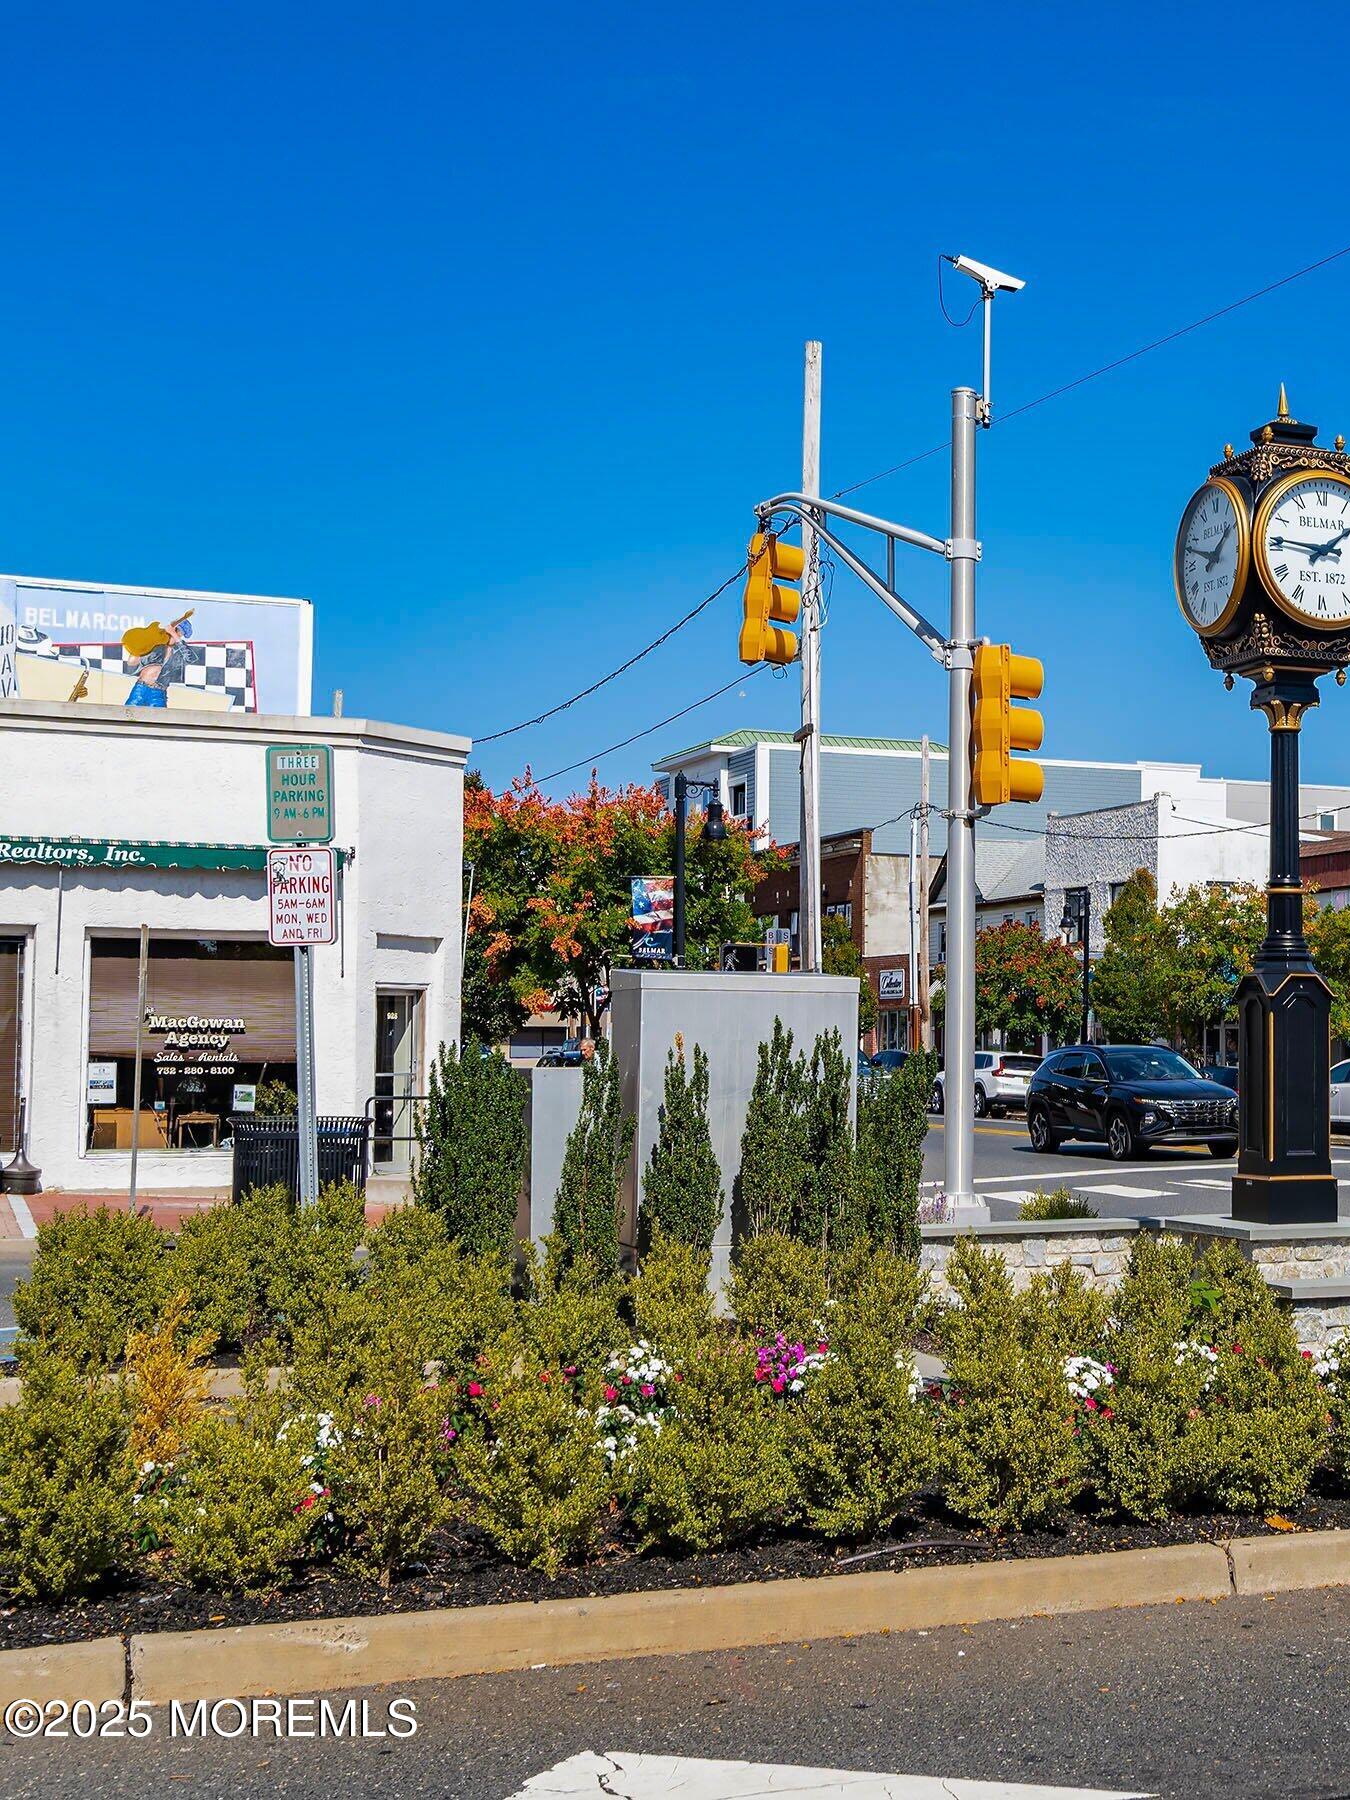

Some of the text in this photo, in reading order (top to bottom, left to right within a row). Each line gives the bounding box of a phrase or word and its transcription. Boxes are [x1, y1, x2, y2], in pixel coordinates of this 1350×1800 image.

[1203, 520, 1228, 540] BELMAR
[1299, 515, 1345, 531] BELMAR
[1299, 570, 1346, 585] EST. 1872
[280, 756, 316, 768] THREE
[281, 773, 316, 786] HOUR
[273, 790, 324, 802] PARKING
[274, 807, 280, 819] 9
[312, 806, 325, 818] PM
[0, 842, 146, 863] Realtors, Inc.
[289, 854, 312, 872] NO
[272, 876, 330, 894] PARKING
[277, 898, 325, 909] 5AM-6AM
[276, 912, 327, 926] MON, WED
[282, 928, 322, 939] AND FRI
[149, 1015, 246, 1029] MacGowan
[164, 1031, 230, 1047] Agency
[154, 1051, 185, 1063] Sales
[198, 1052, 239, 1062] Rentals
